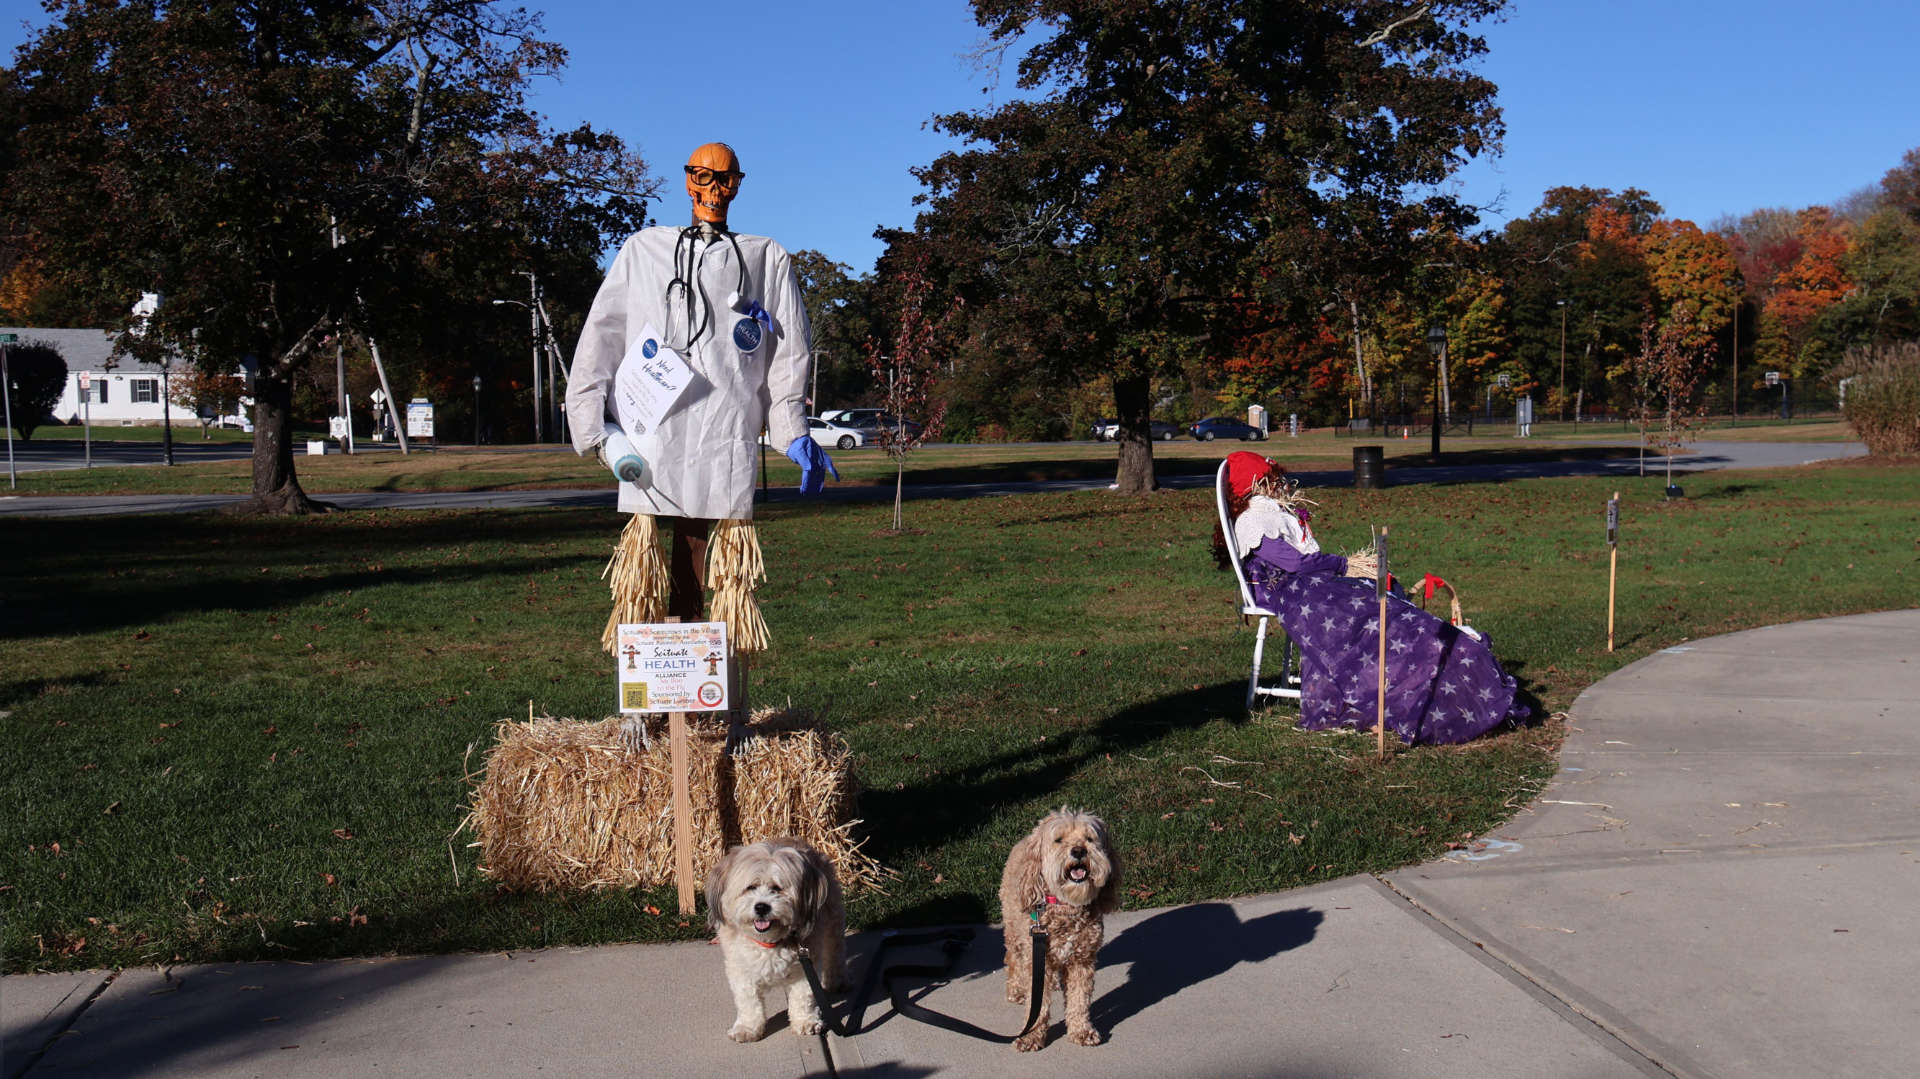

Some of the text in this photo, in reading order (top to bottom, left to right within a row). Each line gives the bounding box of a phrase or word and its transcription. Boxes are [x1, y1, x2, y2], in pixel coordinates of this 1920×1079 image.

[654, 647, 688, 658] Scituate
[645, 660, 696, 670] HEALTH
[683, 690, 690, 698] by
